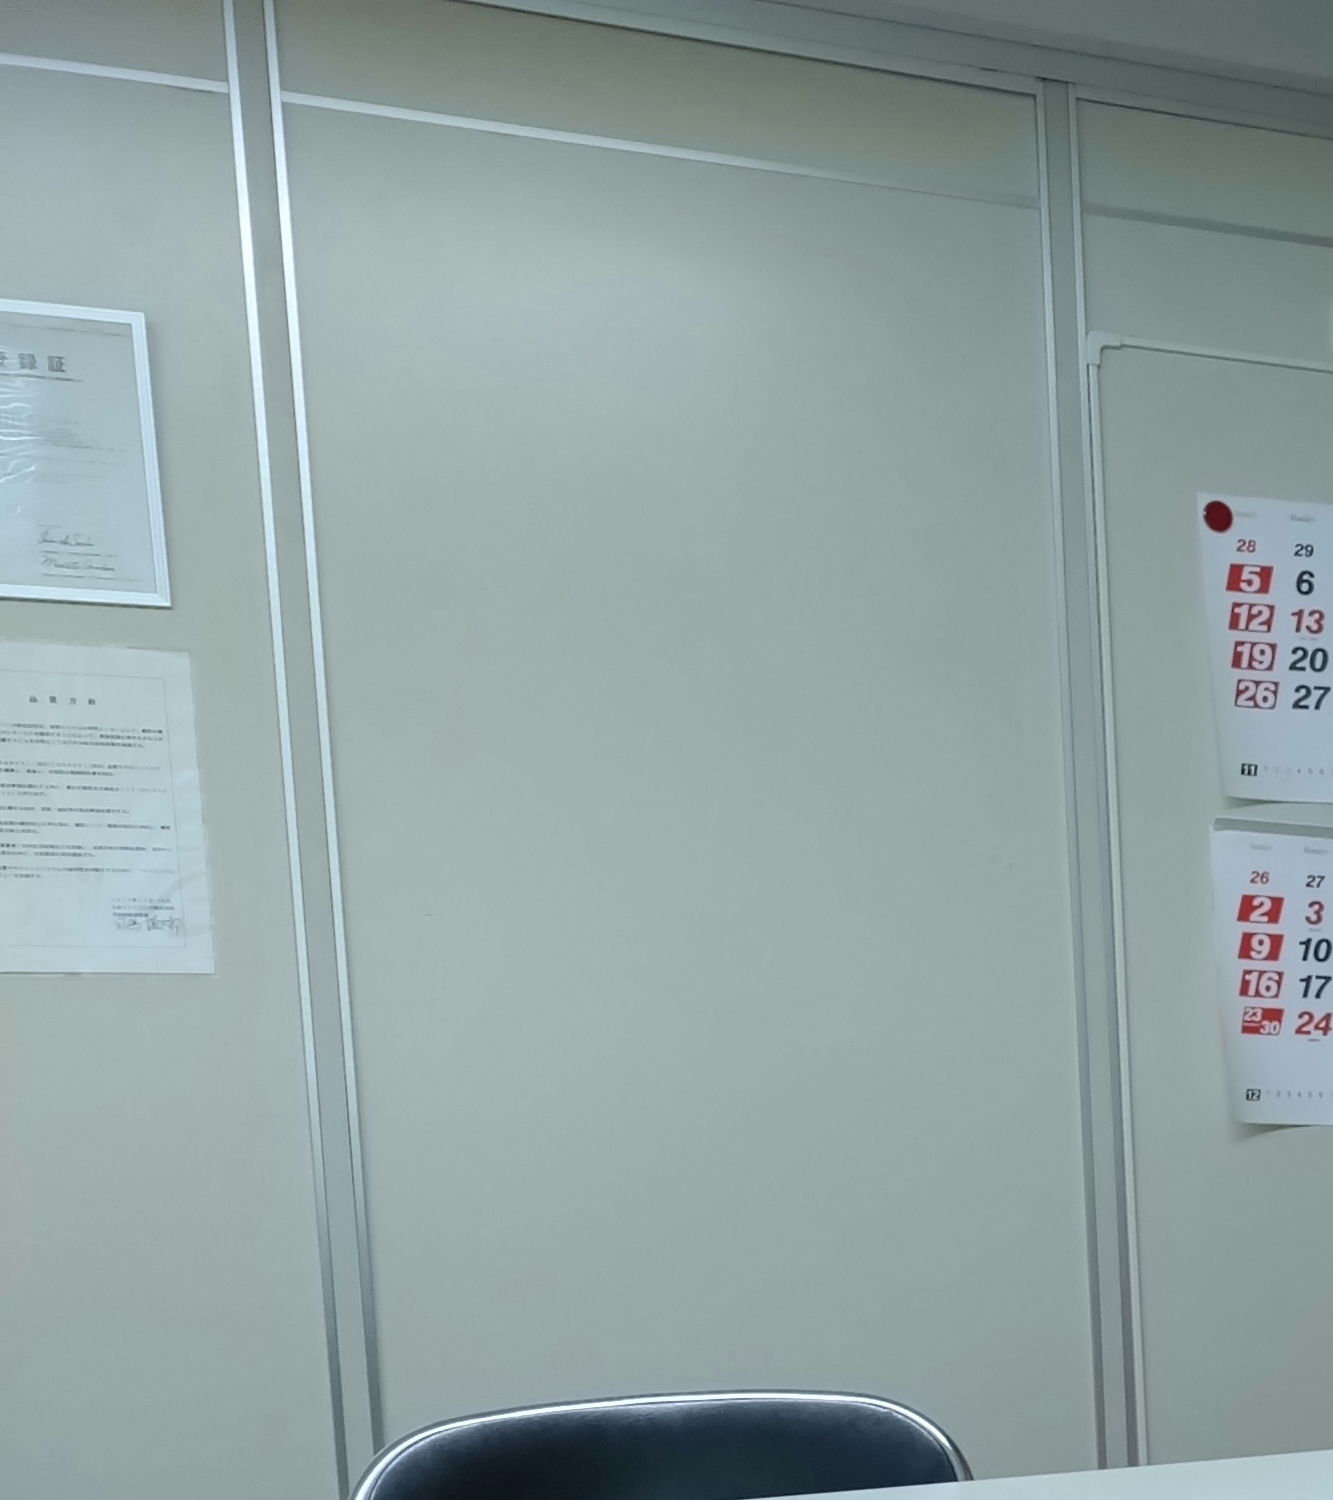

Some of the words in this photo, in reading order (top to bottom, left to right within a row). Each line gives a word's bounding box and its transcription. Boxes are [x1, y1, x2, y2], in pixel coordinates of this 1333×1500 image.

[1236, 539, 1256, 553] 28
[1294, 543, 1314, 558] 29
[1239, 566, 1261, 592] 5
[1296, 570, 1315, 595] 6
[1234, 604, 1271, 631] 12
[1290, 608, 1325, 635] 13
[1236, 644, 1273, 670] 19
[1289, 647, 1329, 673] 20
[1236, 682, 1276, 709] 26
[1292, 685, 1331, 711] 27
[1244, 765, 1256, 775] 11
[1249, 871, 1270, 885] 26
[1306, 874, 1325, 889] 27
[1249, 897, 1271, 923] 2
[1305, 901, 1325, 925] 3
[1250, 935, 1271, 959] 9
[1299, 938, 1332, 963] 10
[1244, 971, 1279, 998] 16
[1299, 974, 1332, 1000] 17
[1243, 1008, 1262, 1022] 23
[1295, 1012, 1333, 1036] 24
[1259, 1020, 1280, 1035] 30
[1248, 1090, 1259, 1100] 12
